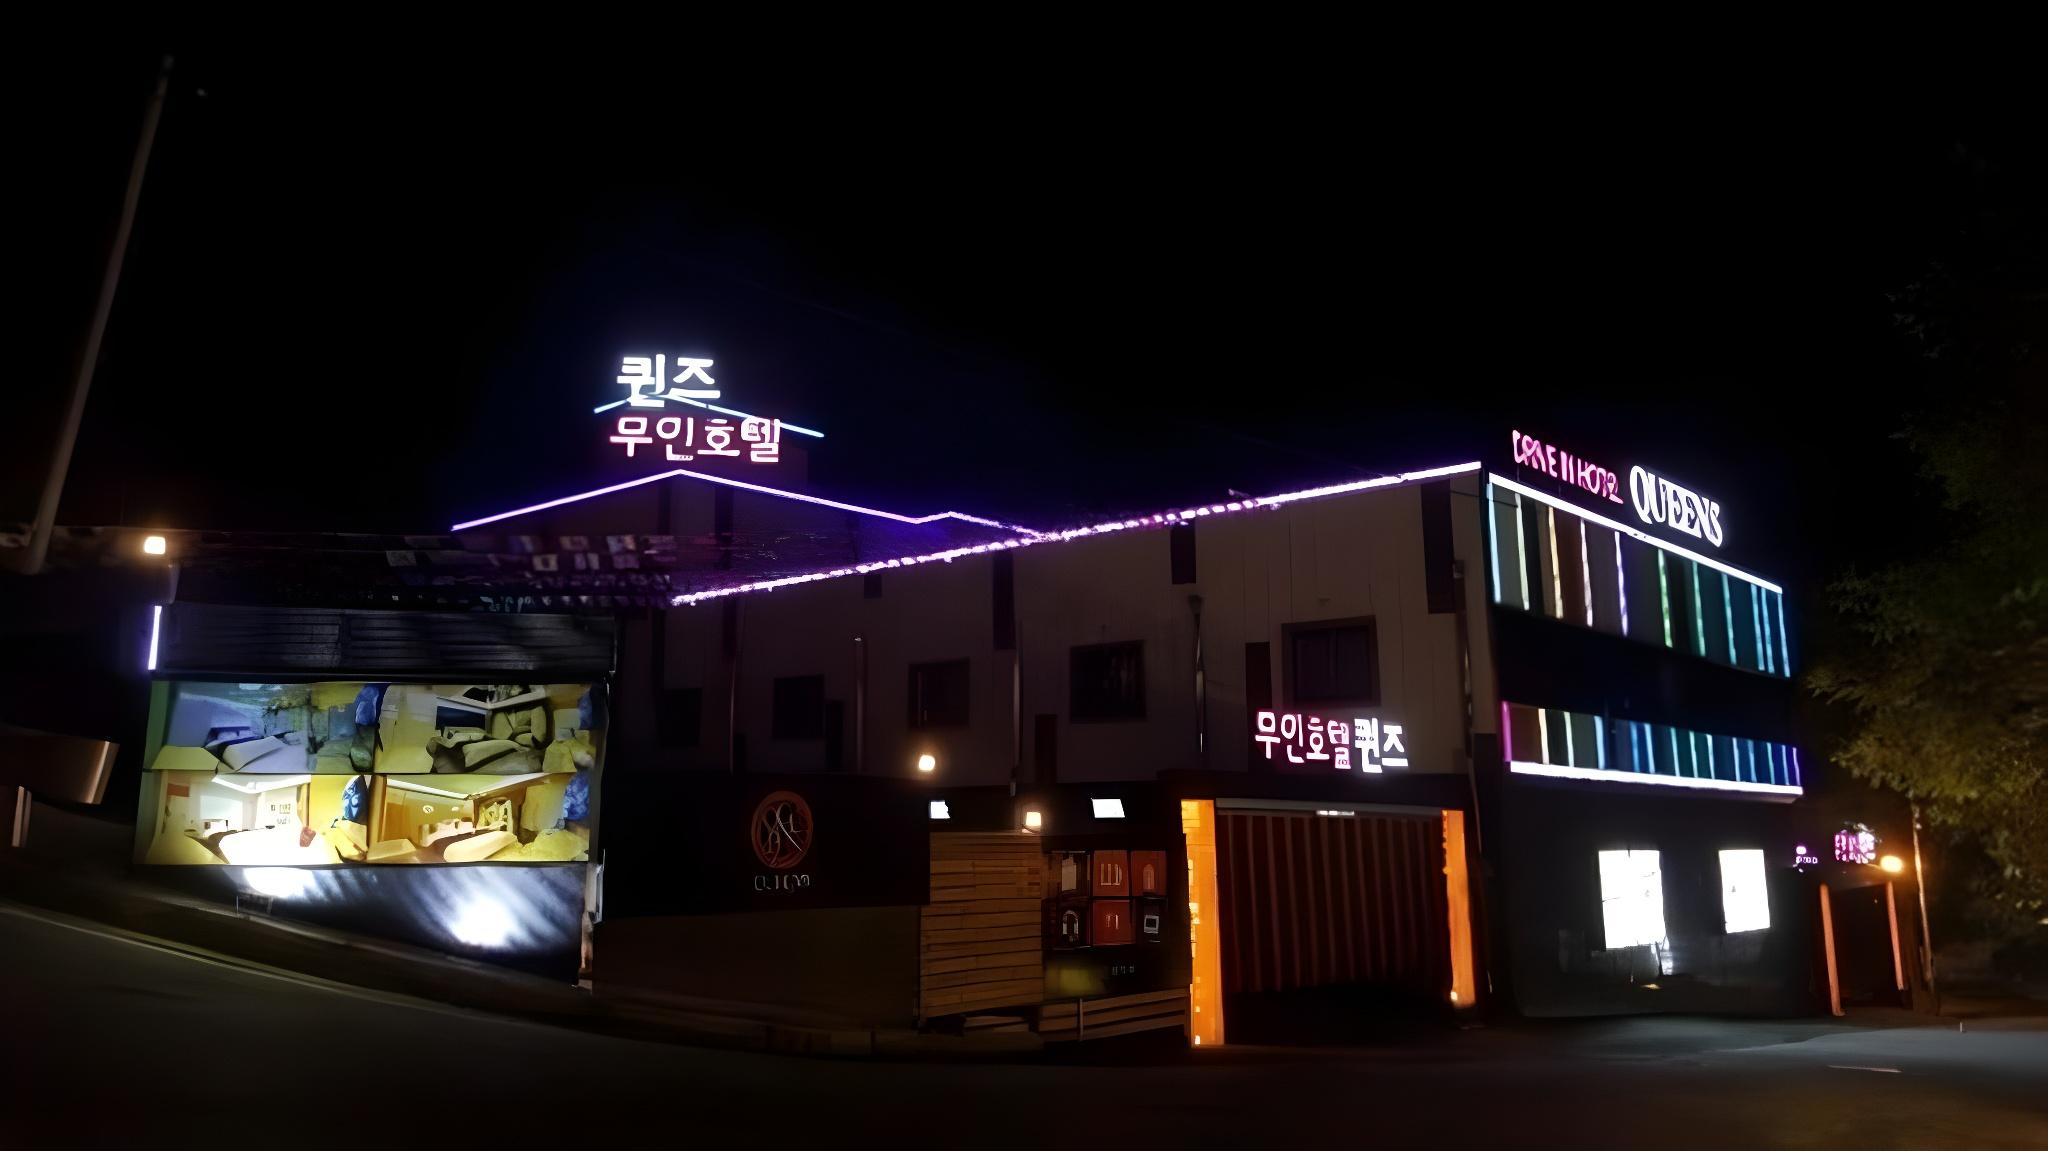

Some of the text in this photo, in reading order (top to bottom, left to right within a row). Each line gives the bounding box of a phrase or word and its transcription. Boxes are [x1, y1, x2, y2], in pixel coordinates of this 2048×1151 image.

[617, 353, 720, 407] 퀸즈
[1629, 465, 1723, 548] QUEENS
[1354, 717, 1408, 773] 퀸즈
